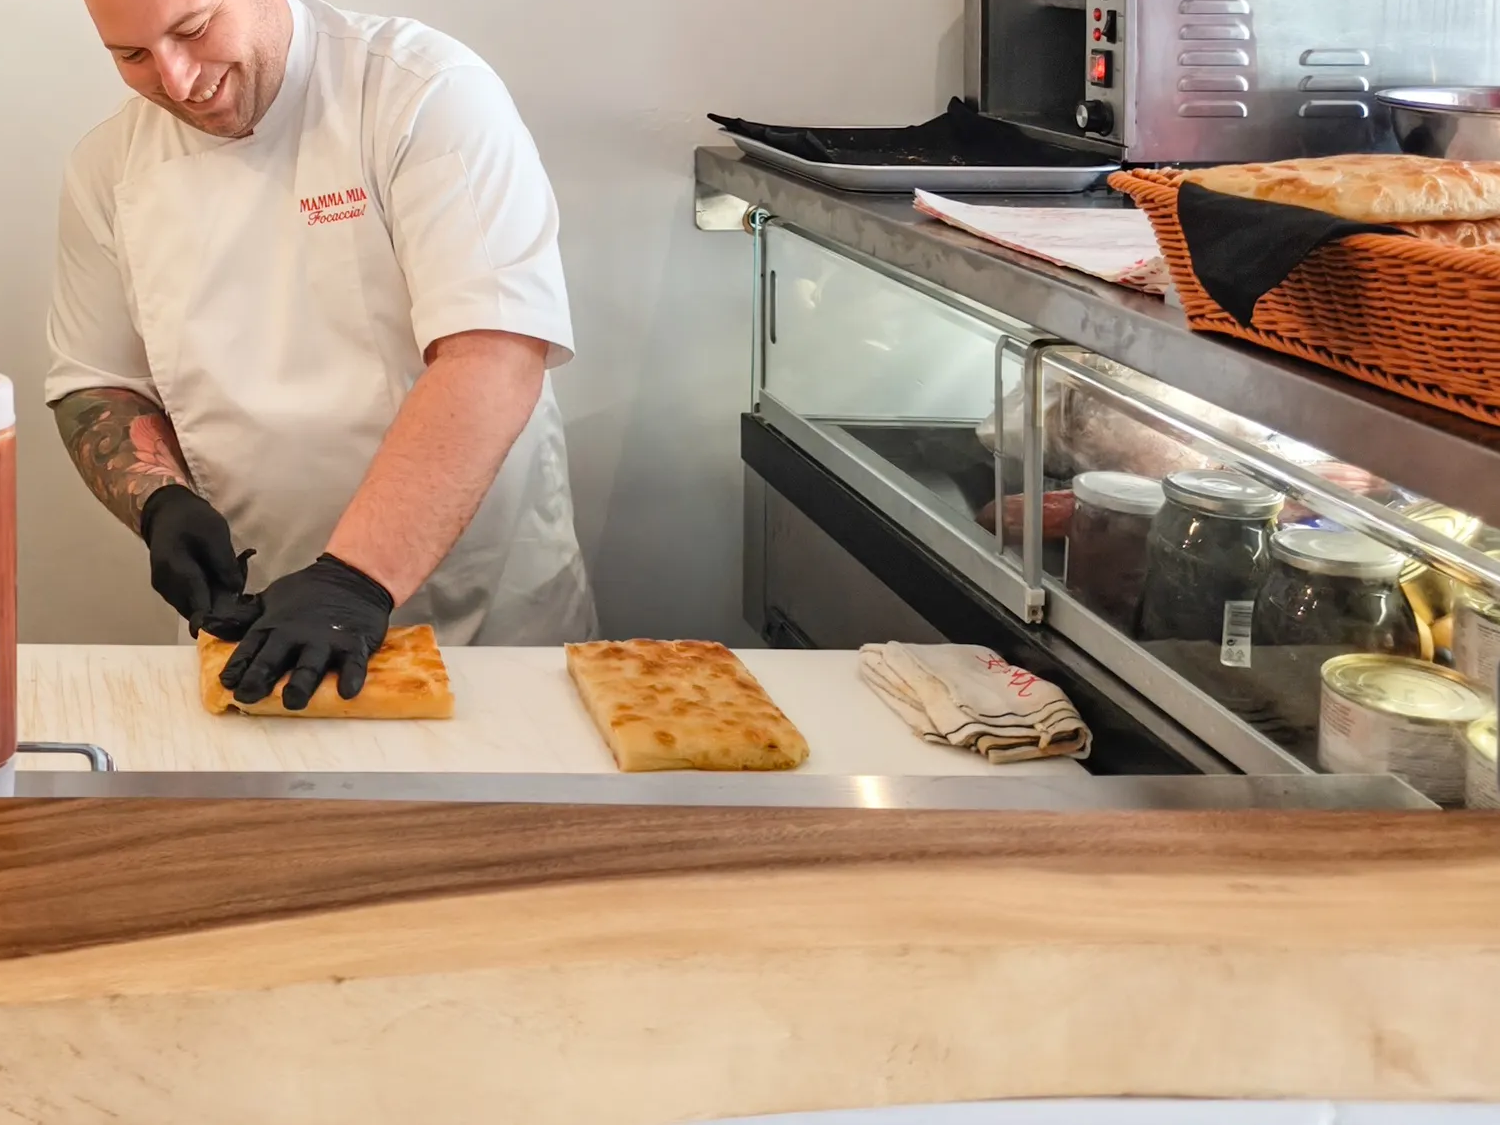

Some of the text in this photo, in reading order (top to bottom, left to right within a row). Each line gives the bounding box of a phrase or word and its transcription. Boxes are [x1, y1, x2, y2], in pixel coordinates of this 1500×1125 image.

[300, 187, 367, 213] MAMMA MIA
[308, 204, 366, 226] Focaccia!
